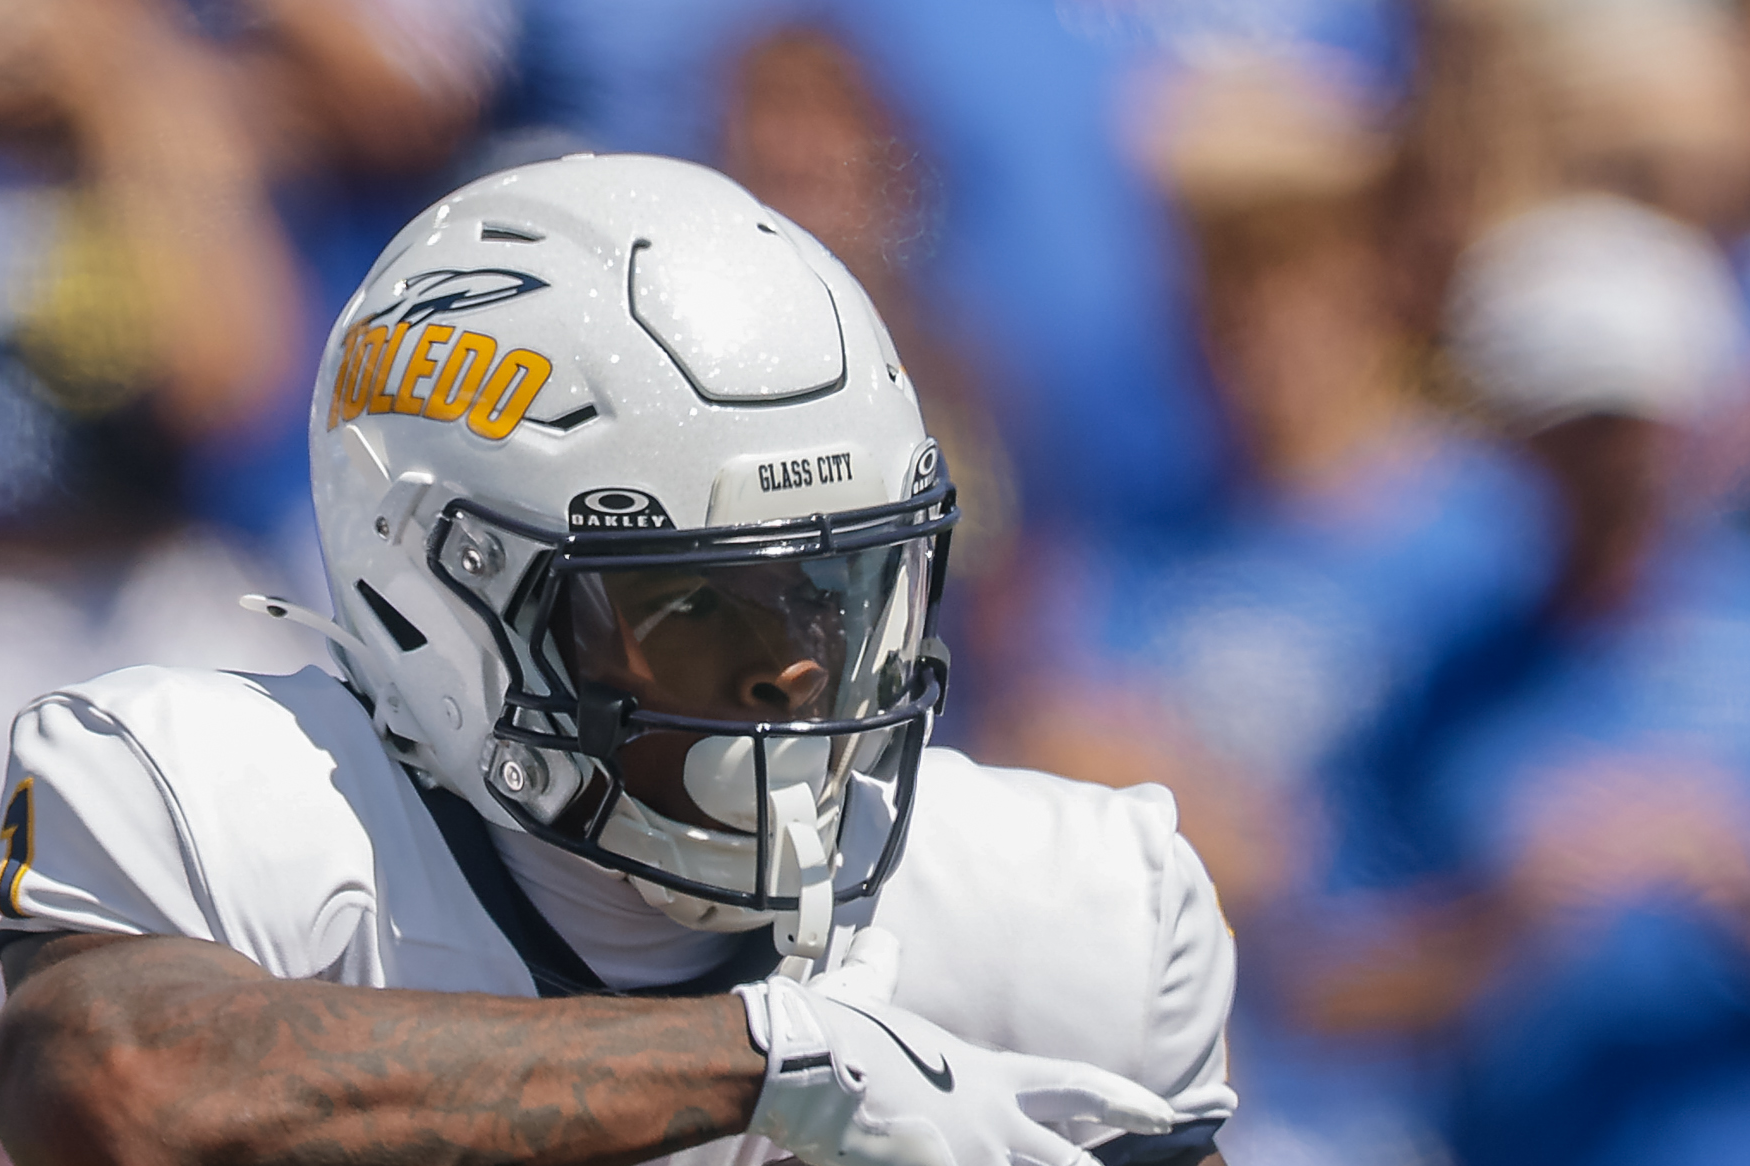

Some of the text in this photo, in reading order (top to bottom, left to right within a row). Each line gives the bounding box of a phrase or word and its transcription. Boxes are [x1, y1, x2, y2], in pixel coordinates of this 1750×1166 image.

[326, 313, 553, 440] TOLEDO
[758, 451, 854, 493] GLASS CITY
[571, 512, 668, 530] OAKLEY
